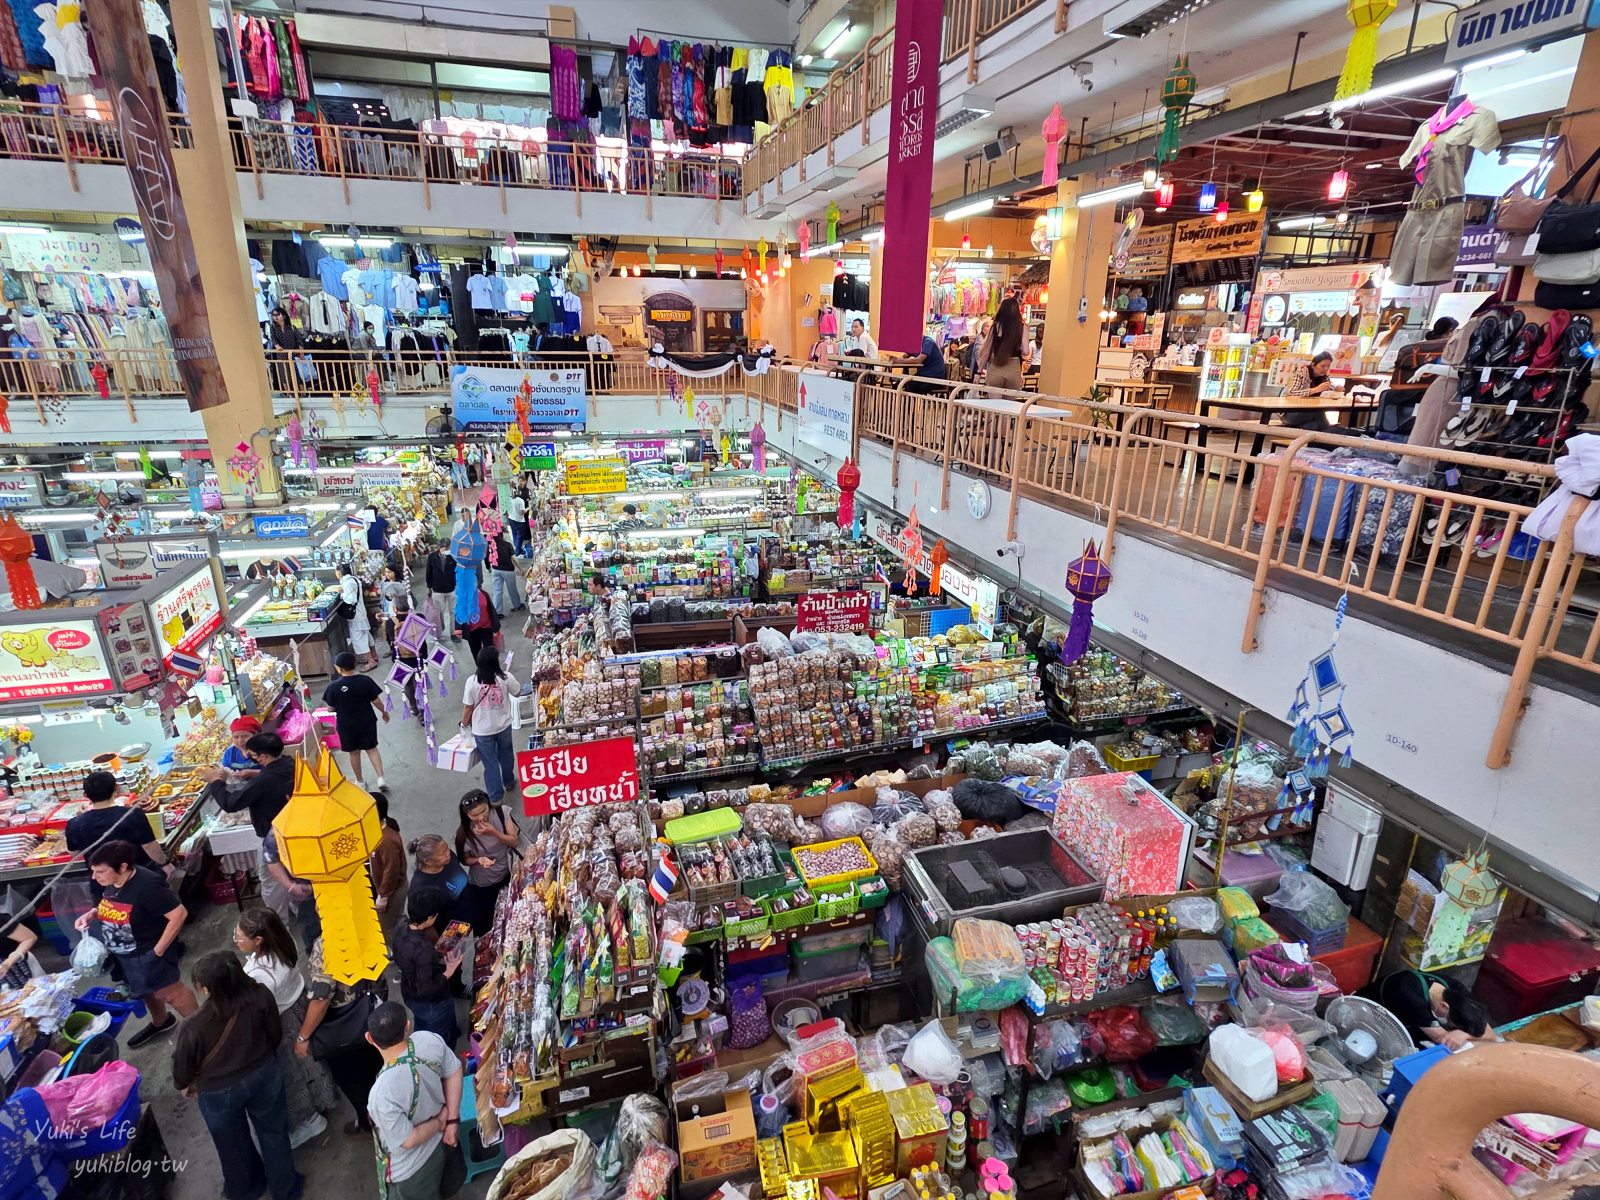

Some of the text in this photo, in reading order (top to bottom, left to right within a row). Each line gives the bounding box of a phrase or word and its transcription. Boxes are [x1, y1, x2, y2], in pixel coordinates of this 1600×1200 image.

[1282, 274, 1348, 287] Smoothie Yogurt
[1178, 293, 1206, 306] Coffee
[459, 401, 489, 409] ตลาดสด
[824, 424, 849, 441] REST AREA
[157, 576, 211, 622] ร้านศรีพรรณ
[801, 591, 868, 612] ร้านป้าแก้ว
[0, 669, 69, 682] หนมป้าย่น
[520, 749, 588, 783] เจ้เปีย
[549, 770, 636, 811] เฮียหน้ำ
